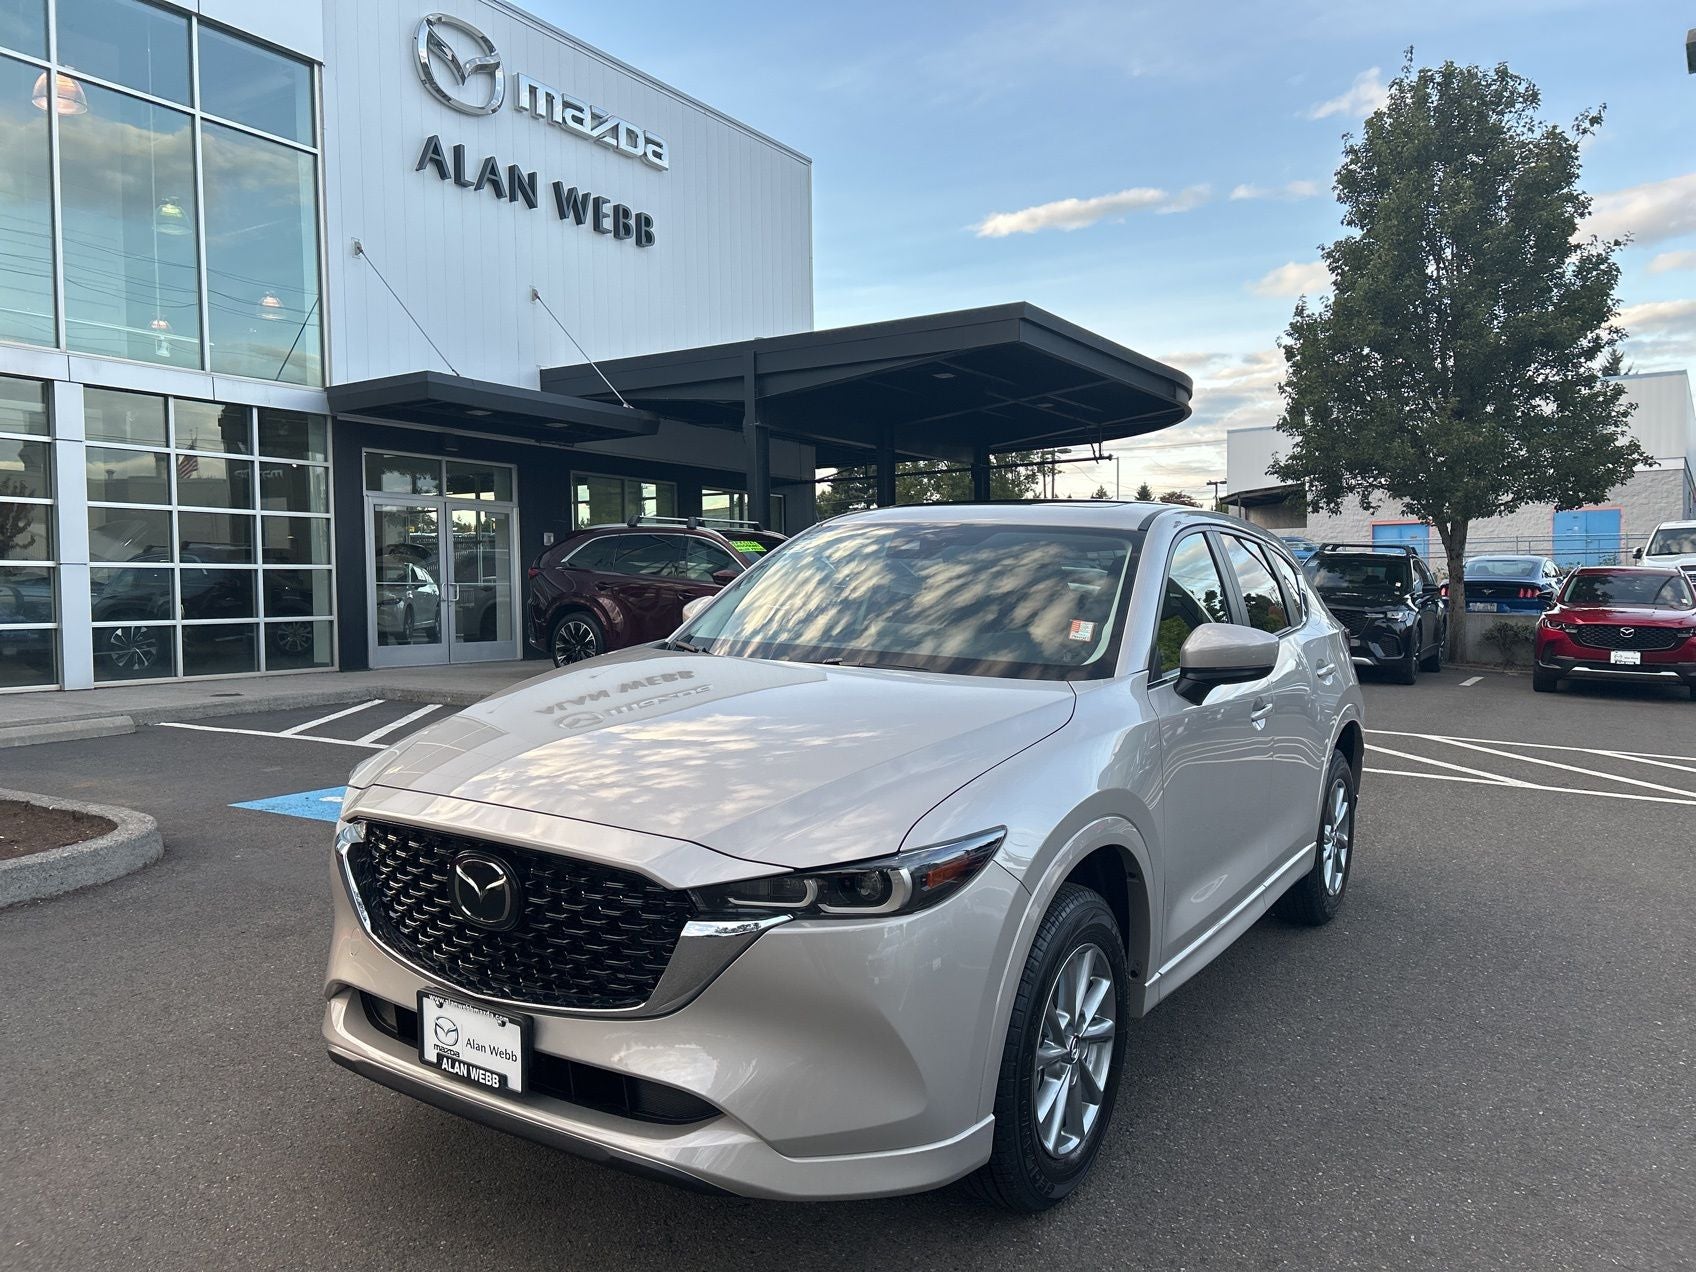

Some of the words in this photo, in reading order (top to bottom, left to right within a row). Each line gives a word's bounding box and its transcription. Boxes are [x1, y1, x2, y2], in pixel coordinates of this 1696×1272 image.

[513, 72, 668, 171] mazda
[415, 134, 538, 209] ALAN
[552, 180, 655, 248] WEBB
[433, 1044, 460, 1057] mazda
[465, 1038, 486, 1052] Alan
[489, 1044, 518, 1063] Webb
[441, 1057, 468, 1078] ALAN
[469, 1067, 500, 1088] WEBB
